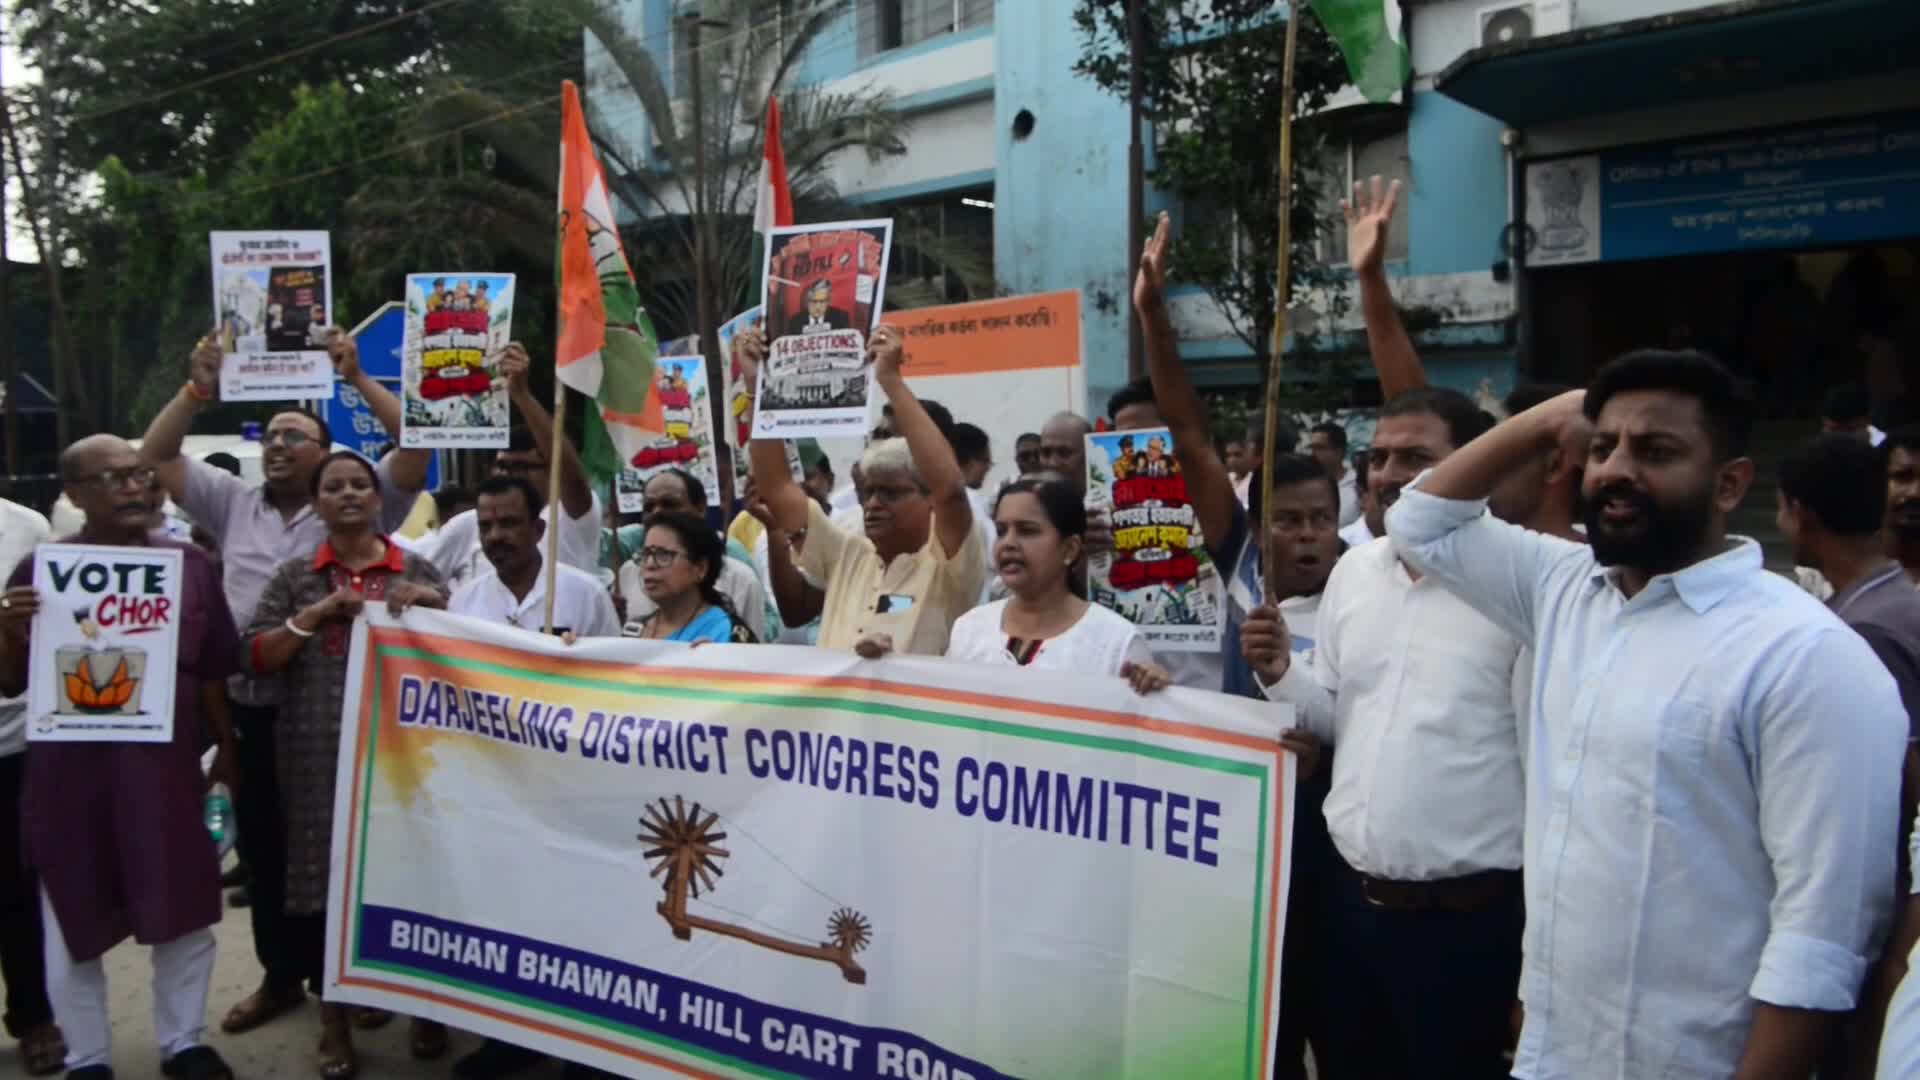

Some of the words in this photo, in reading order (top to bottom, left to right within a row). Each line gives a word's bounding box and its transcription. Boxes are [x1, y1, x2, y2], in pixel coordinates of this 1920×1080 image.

[776, 341, 789, 357] 14
[48, 553, 167, 594] VOTE
[97, 594, 170, 626] CHOR
[400, 677, 574, 753] DARJEELING
[579, 711, 729, 775] DISTRICT
[745, 728, 940, 809] CONGRESS
[955, 756, 1221, 867] COMMITTEE
[391, 920, 508, 973] BIDHAN
[517, 949, 667, 1021] BHAWAN,
[680, 992, 751, 1044] HILL
[761, 1018, 861, 1071] CART
